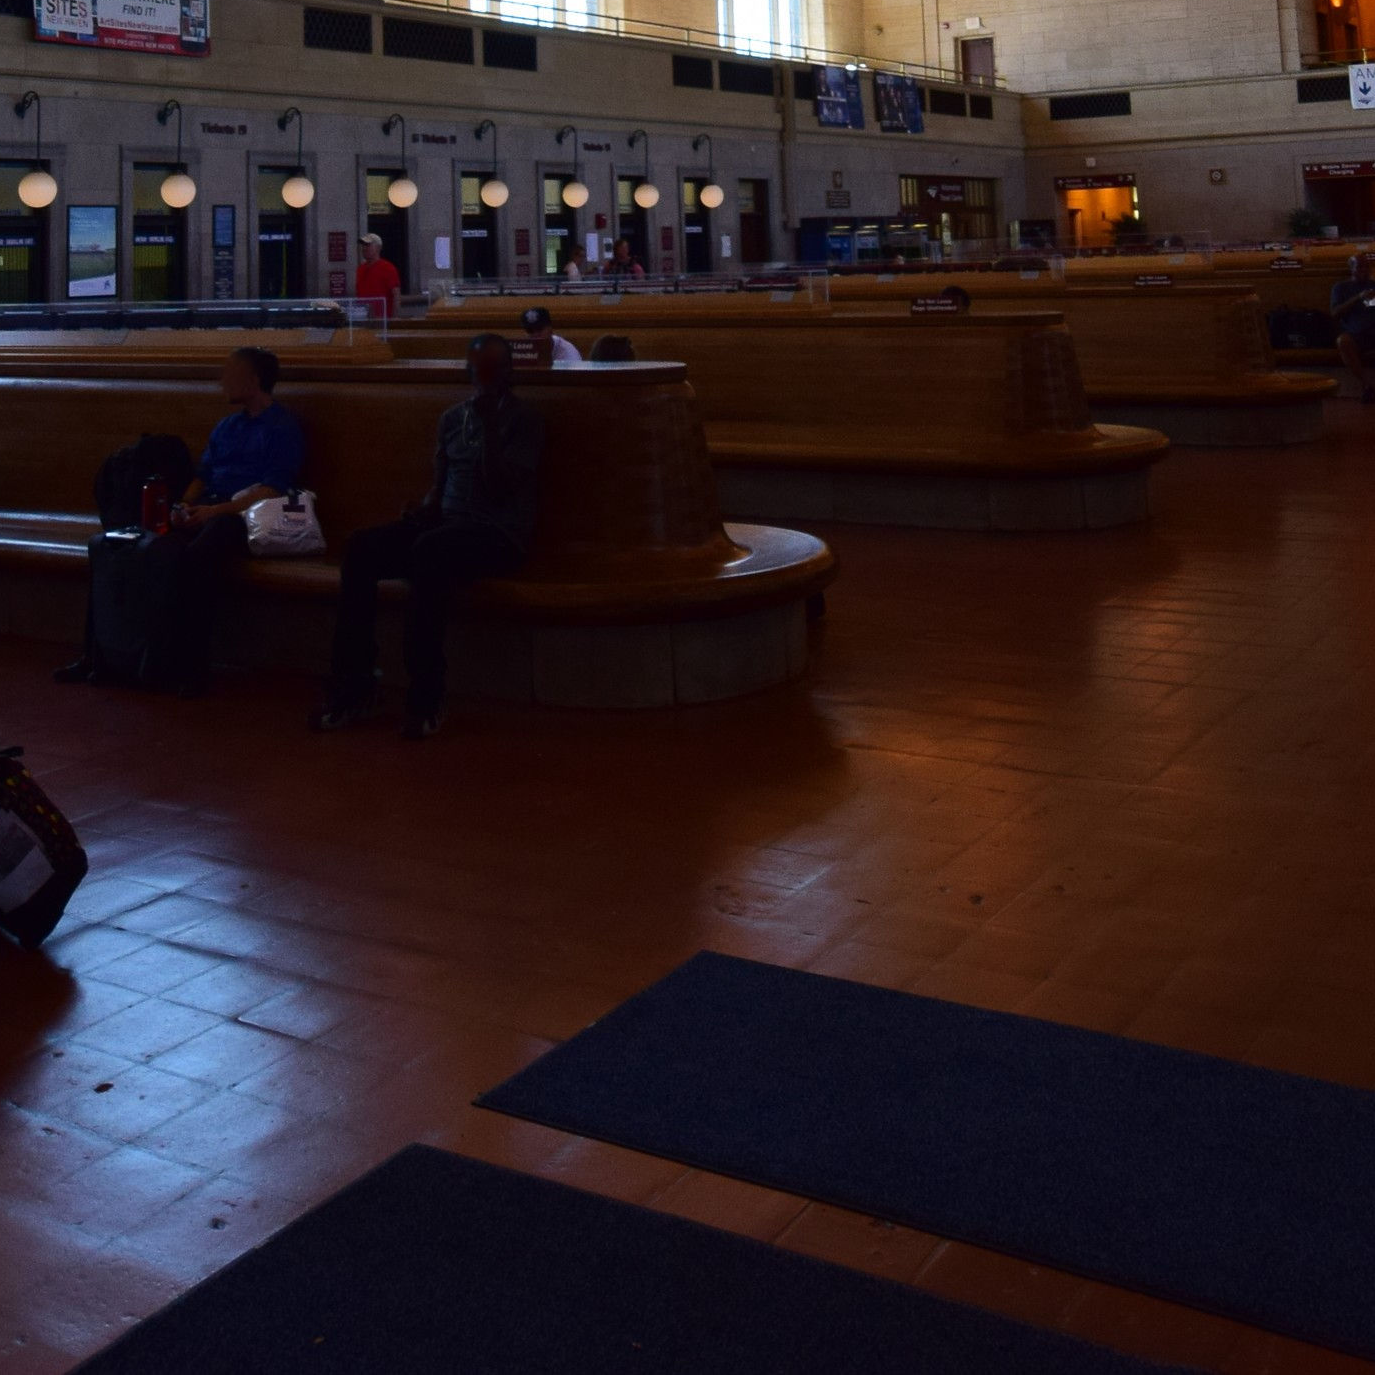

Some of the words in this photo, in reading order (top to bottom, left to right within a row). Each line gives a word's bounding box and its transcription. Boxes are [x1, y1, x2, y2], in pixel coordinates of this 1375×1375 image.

[123, 5, 142, 16] FIND
[144, 7, 157, 17] IT!
[100, 17, 177, 33] ArtSitesNewHaven.com
[201, 122, 235, 136] Tickets
[513, 342, 534, 350] Leave
